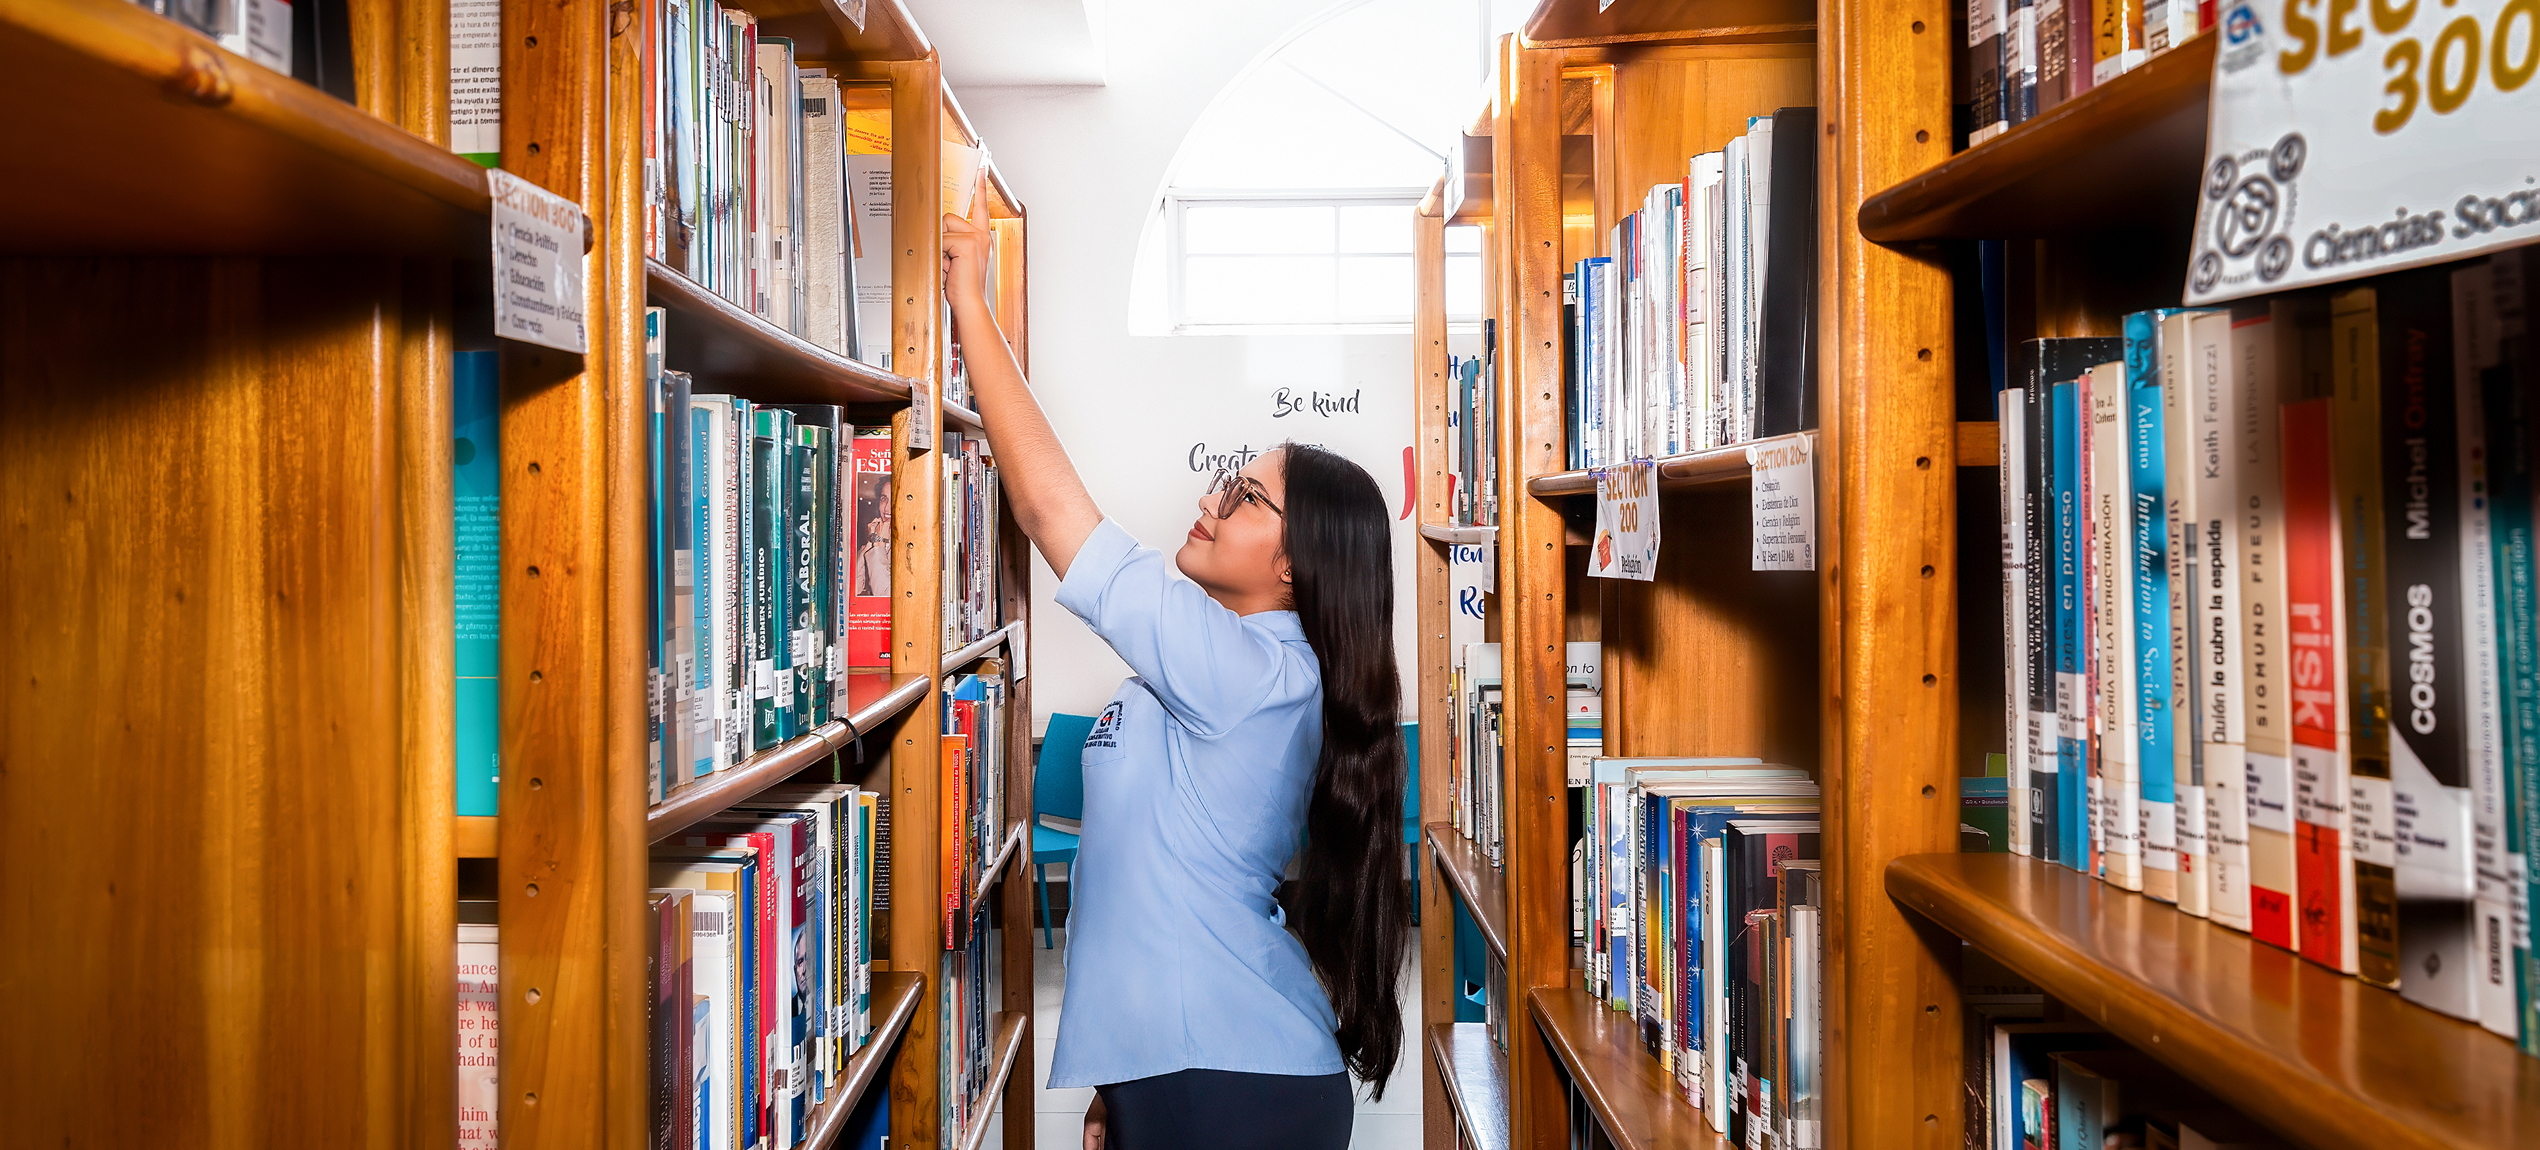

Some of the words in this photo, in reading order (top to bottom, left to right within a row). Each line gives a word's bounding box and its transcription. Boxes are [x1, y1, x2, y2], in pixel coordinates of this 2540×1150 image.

[2302, 206, 2447, 270] Ciencias
[1271, 387, 1306, 418] Be
[1312, 389, 1360, 418] kind
[2203, 343, 2218, 423] Ferrazzi
[870, 448, 891, 458] Señ
[1755, 448, 1788, 472] SECTION
[2137, 403, 2153, 469] Adorno
[2205, 430, 2220, 479] Keith
[701, 431, 709, 498] General
[856, 458, 891, 473] ESP
[1606, 463, 1648, 501] SECTION
[2405, 438, 2430, 540] Michel
[1620, 501, 1638, 533] 200
[2061, 490, 2075, 577] proceso
[2250, 495, 2263, 582] FREUD
[757, 547, 766, 599] JURÍDICO
[799, 510, 812, 605] LABORAL
[1621, 554, 1642, 578] Religión
[2102, 493, 2114, 629] ESTRUCTURACIÓN
[2137, 493, 2159, 613] Introduction
[2207, 519, 2225, 588] espalda
[2062, 586, 2073, 610] en
[758, 601, 766, 659] RÉGIMEN
[2105, 634, 2115, 653] LA
[2142, 617, 2153, 640] to
[2208, 617, 2226, 665] cubre
[1582, 663, 1594, 674] to
[2106, 656, 2116, 675] DE
[2253, 603, 2268, 726] SIGMUND
[2290, 602, 2333, 729] risk
[2408, 583, 2437, 735] COSMOS
[2107, 679, 2117, 733] TEORÍA
[2141, 646, 2159, 745] Sociology
[458, 1000, 470, 1012] st
[476, 1001, 496, 1012] wa
[460, 1019, 474, 1030] re
[481, 1016, 499, 1030] he
[468, 1034, 484, 1048] of
[461, 1107, 488, 1122] him
